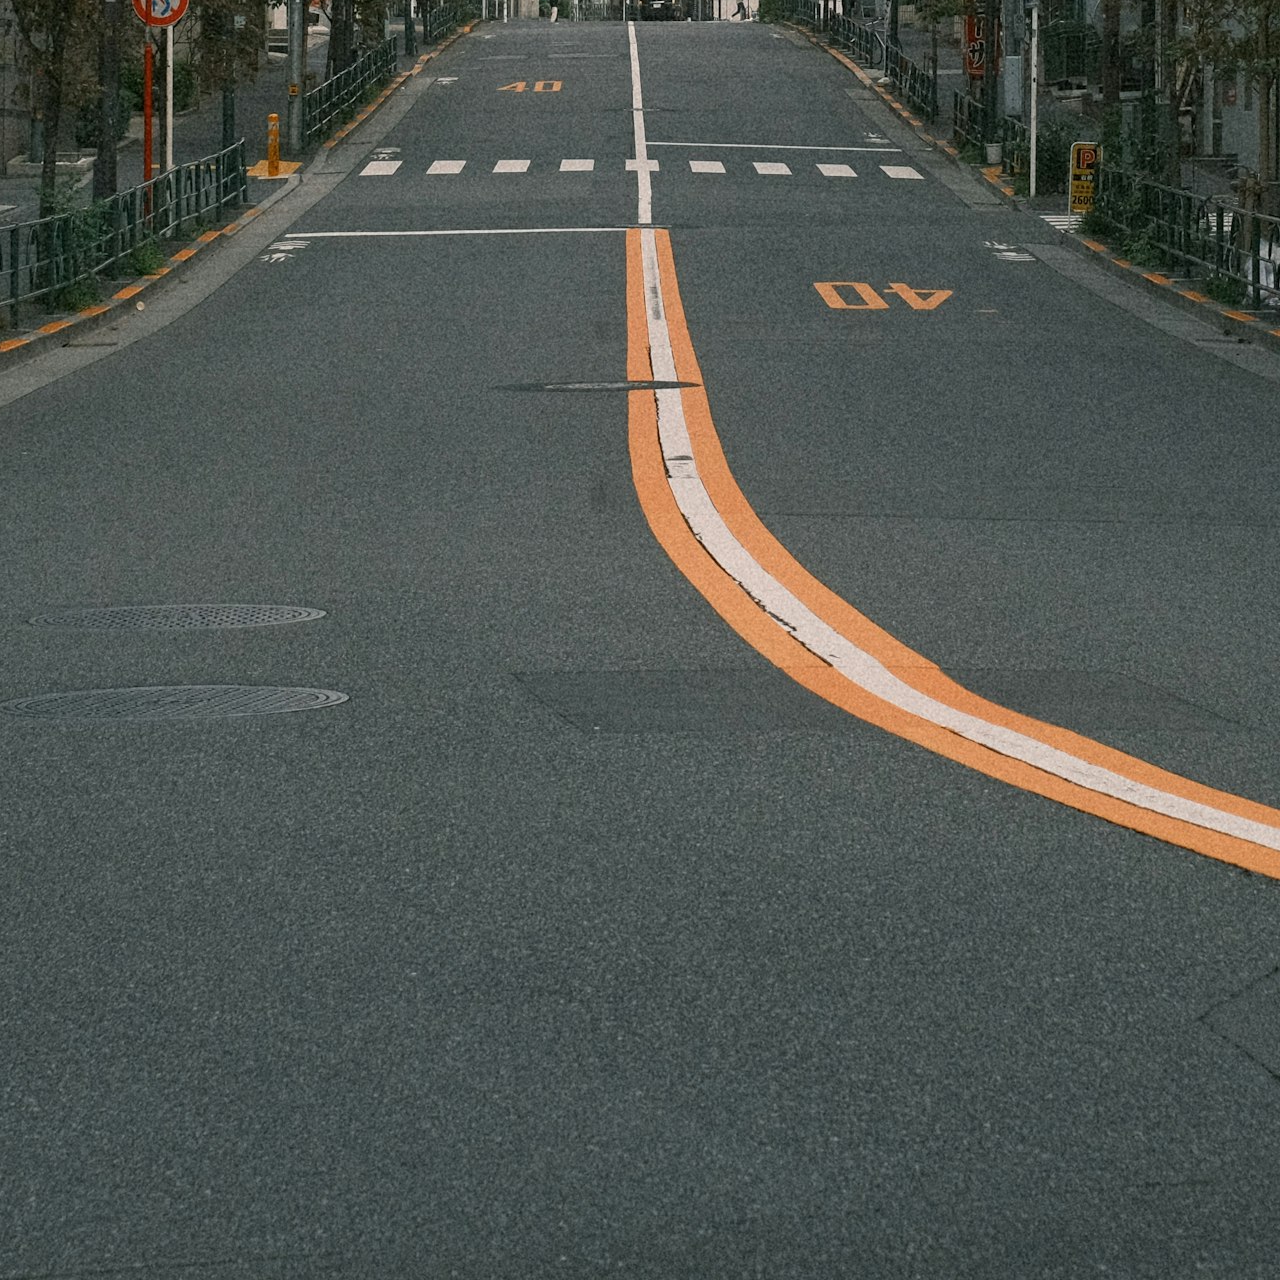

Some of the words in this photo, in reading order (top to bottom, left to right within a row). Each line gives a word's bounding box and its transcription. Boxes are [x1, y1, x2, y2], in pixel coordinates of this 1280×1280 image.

[497, 80, 562, 92] 40
[1080, 149, 1096, 169] P
[813, 281, 954, 310] 40
